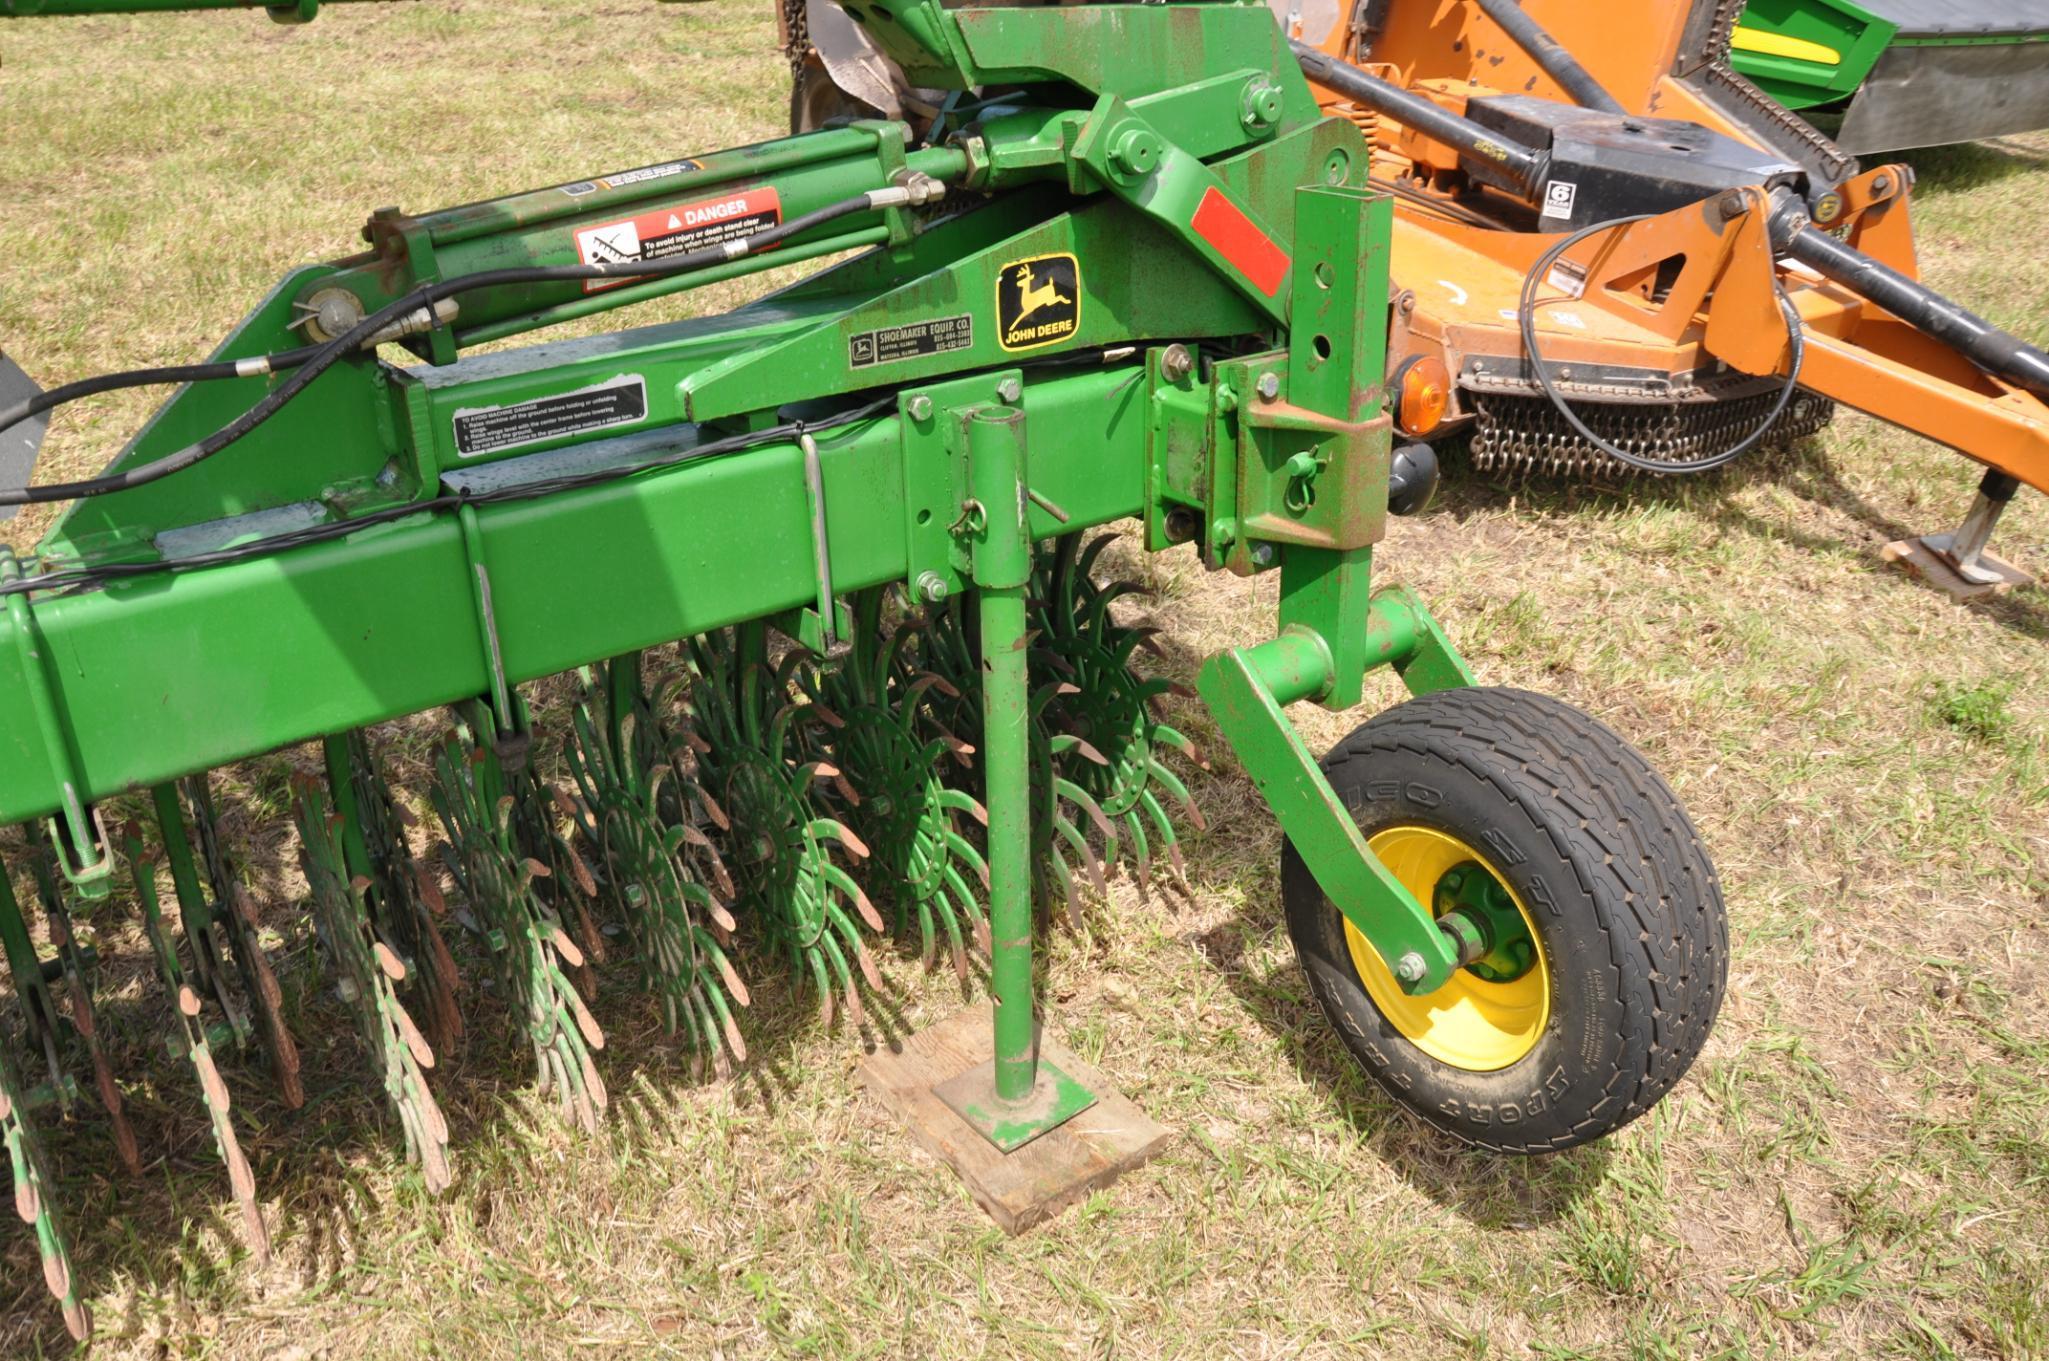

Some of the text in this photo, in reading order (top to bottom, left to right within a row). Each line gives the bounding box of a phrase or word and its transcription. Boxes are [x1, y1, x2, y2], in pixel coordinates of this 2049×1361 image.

[1551, 185, 1570, 202] 6
[686, 200, 747, 225] DANGER
[645, 217, 759, 250] To avoid injury or death stand clear
[646, 221, 774, 258] of machine when wings are being folded
[880, 319, 969, 343] SHOEMAKER EQUIP. CO.
[1006, 319, 1073, 345] JOHN DEERE
[469, 421, 484, 429] Raise
[485, 416, 509, 425] machine
[528, 408, 548, 418] ground
[548, 405, 565, 413] before
[566, 401, 585, 410] folding
[592, 394, 617, 405] unfolding
[470, 414, 488, 422] AVOID
[488, 409, 513, 419] MACHINE
[514, 404, 537, 414] DAMAGE
[470, 432, 486, 440] Raise
[487, 428, 503, 438] wings
[504, 425, 517, 433] level
[540, 418, 557, 426] center
[558, 414, 573, 422] frame
[574, 410, 591, 419] before
[592, 406, 614, 417] lowering
[470, 426, 487, 435] wings.
[471, 436, 495, 445] machine
[512, 428, 533, 438] ground.
[508, 434, 530, 443] machine
[548, 427, 567, 436] ground
[582, 420, 601, 429] making
[607, 416, 621, 424] sharp
[1439, 1064, 1570, 1126] SPORT
